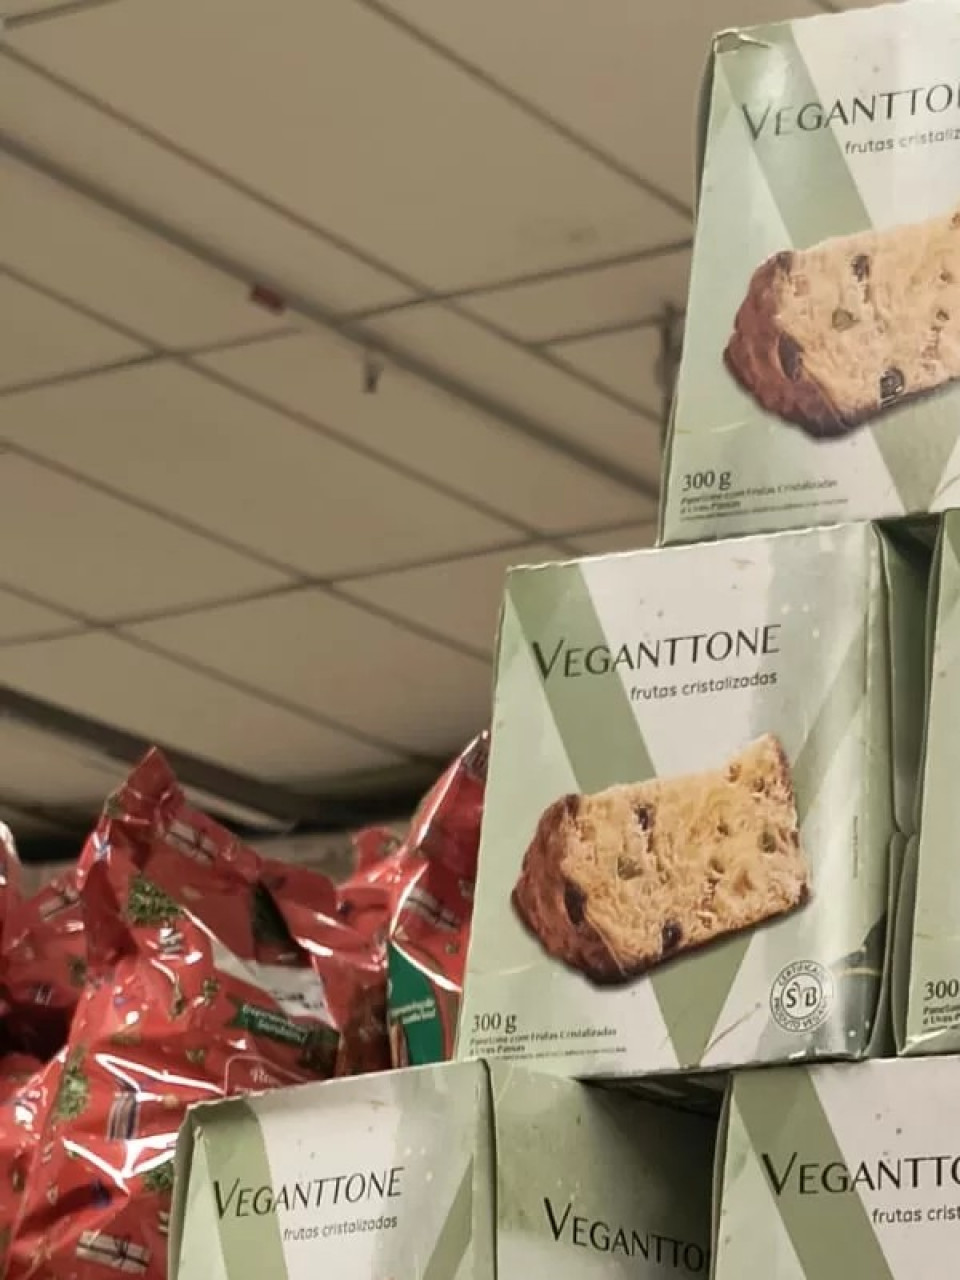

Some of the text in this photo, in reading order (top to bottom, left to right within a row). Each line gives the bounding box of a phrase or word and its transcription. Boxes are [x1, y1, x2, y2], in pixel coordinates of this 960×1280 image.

[845, 137, 894, 155] frutas
[682, 470, 731, 491] 300 g
[532, 625, 781, 680] VEGANTTONE
[630, 671, 777, 701] frutas cristalizadas
[924, 979, 959, 1000] 300
[472, 1013, 517, 1033] 300 g
[213, 1166, 405, 1219] VEGANTTONE
[872, 1208, 923, 1226] frutas
[283, 1215, 398, 1242] frutas cristalizadas
